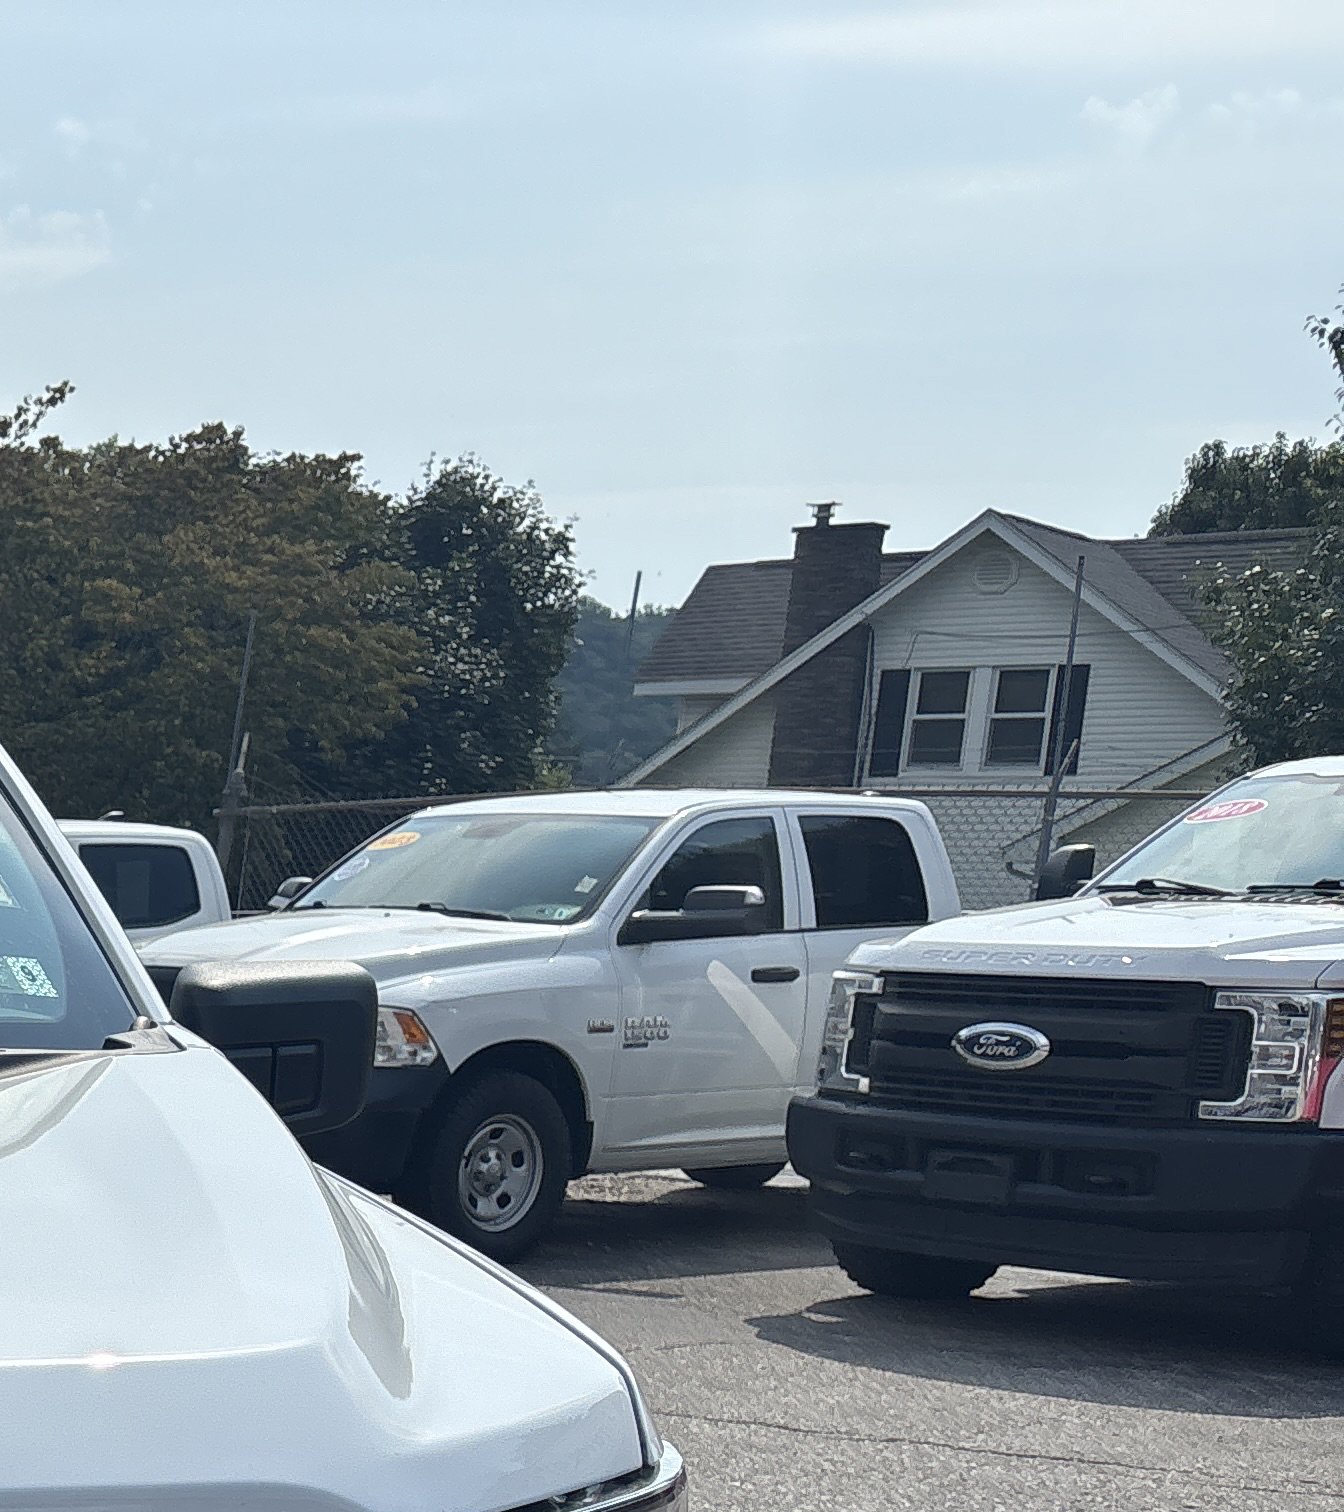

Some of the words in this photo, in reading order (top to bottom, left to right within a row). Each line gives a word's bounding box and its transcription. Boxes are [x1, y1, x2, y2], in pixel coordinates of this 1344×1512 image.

[921, 948, 1038, 966] SUPER
[1042, 952, 1150, 969] DUTY
[973, 1033, 1022, 1057] Ford
